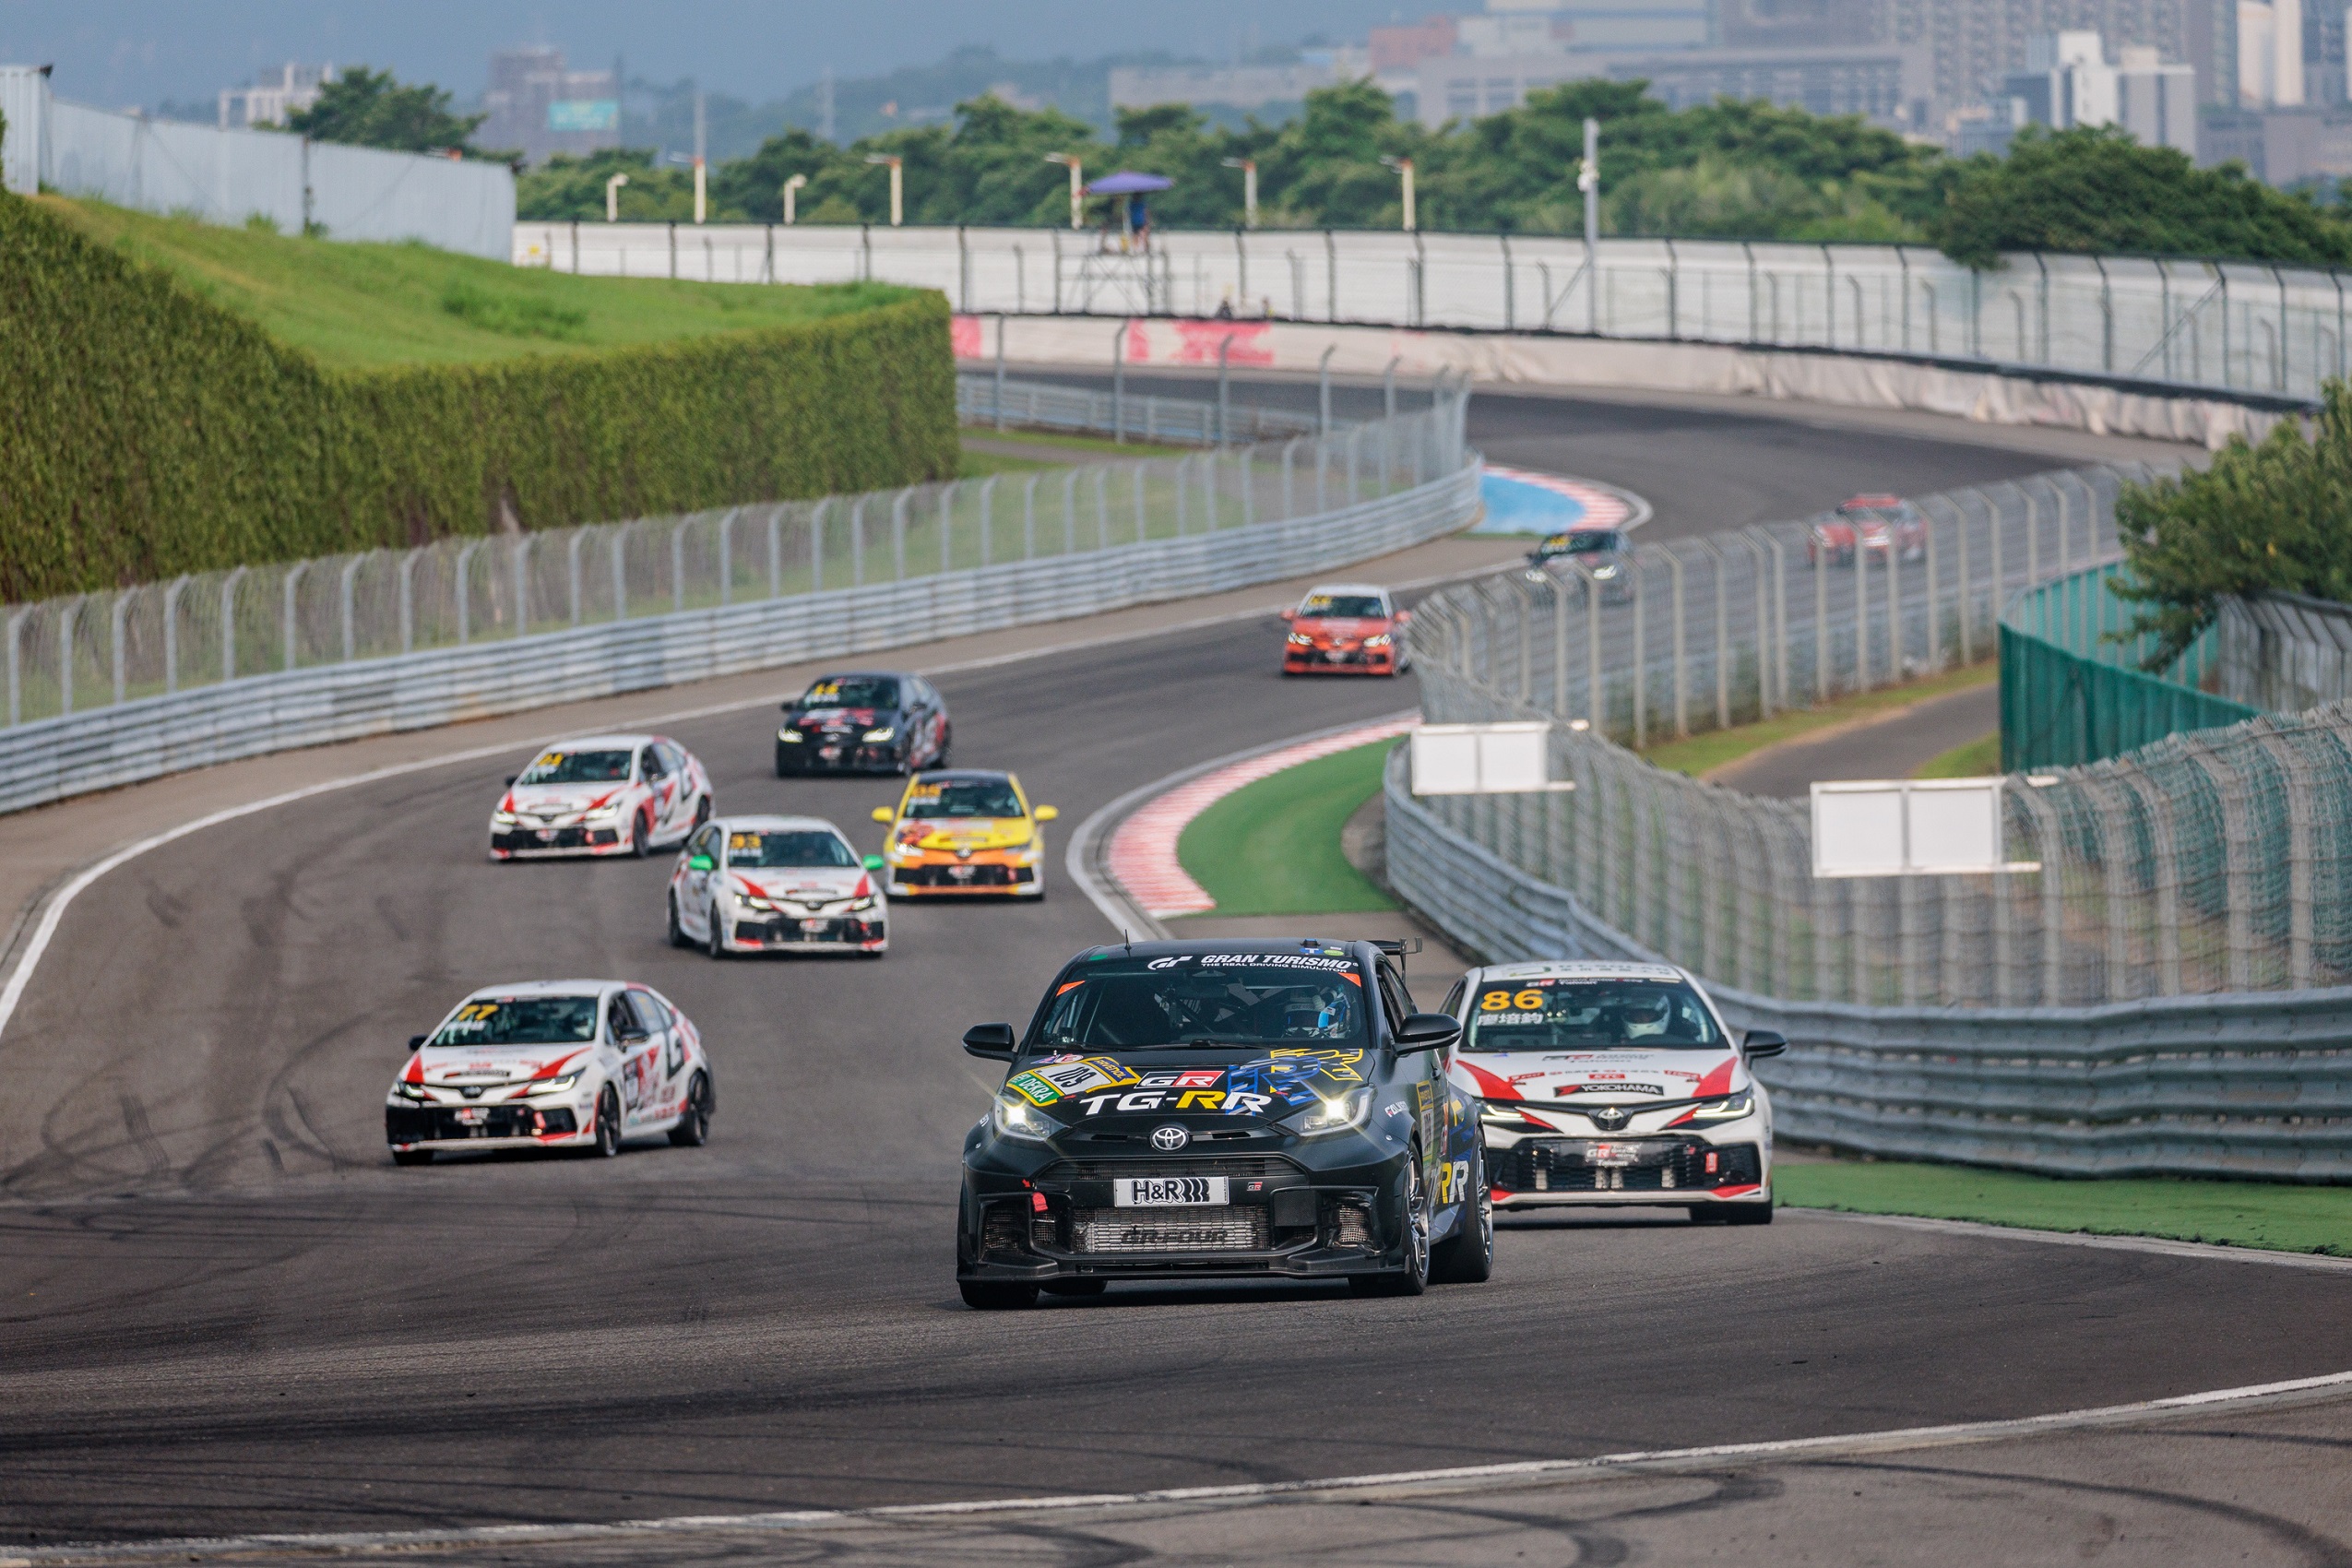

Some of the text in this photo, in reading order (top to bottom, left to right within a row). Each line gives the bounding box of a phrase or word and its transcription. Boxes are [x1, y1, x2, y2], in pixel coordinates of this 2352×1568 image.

[1201, 955, 1352, 969] GRAN TURISMO
[1291, 964, 1347, 973] SIMULATOR
[1480, 989, 1544, 1011] 86
[1048, 1066, 1098, 1088] 109
[1138, 1075, 1215, 1087] GR
[1018, 1077, 1054, 1102] DEKRA
[1581, 1083, 1659, 1095] YOKOHAMA
[1079, 1090, 1273, 1115] TG-RR
[1132, 1179, 1185, 1203] H&R
